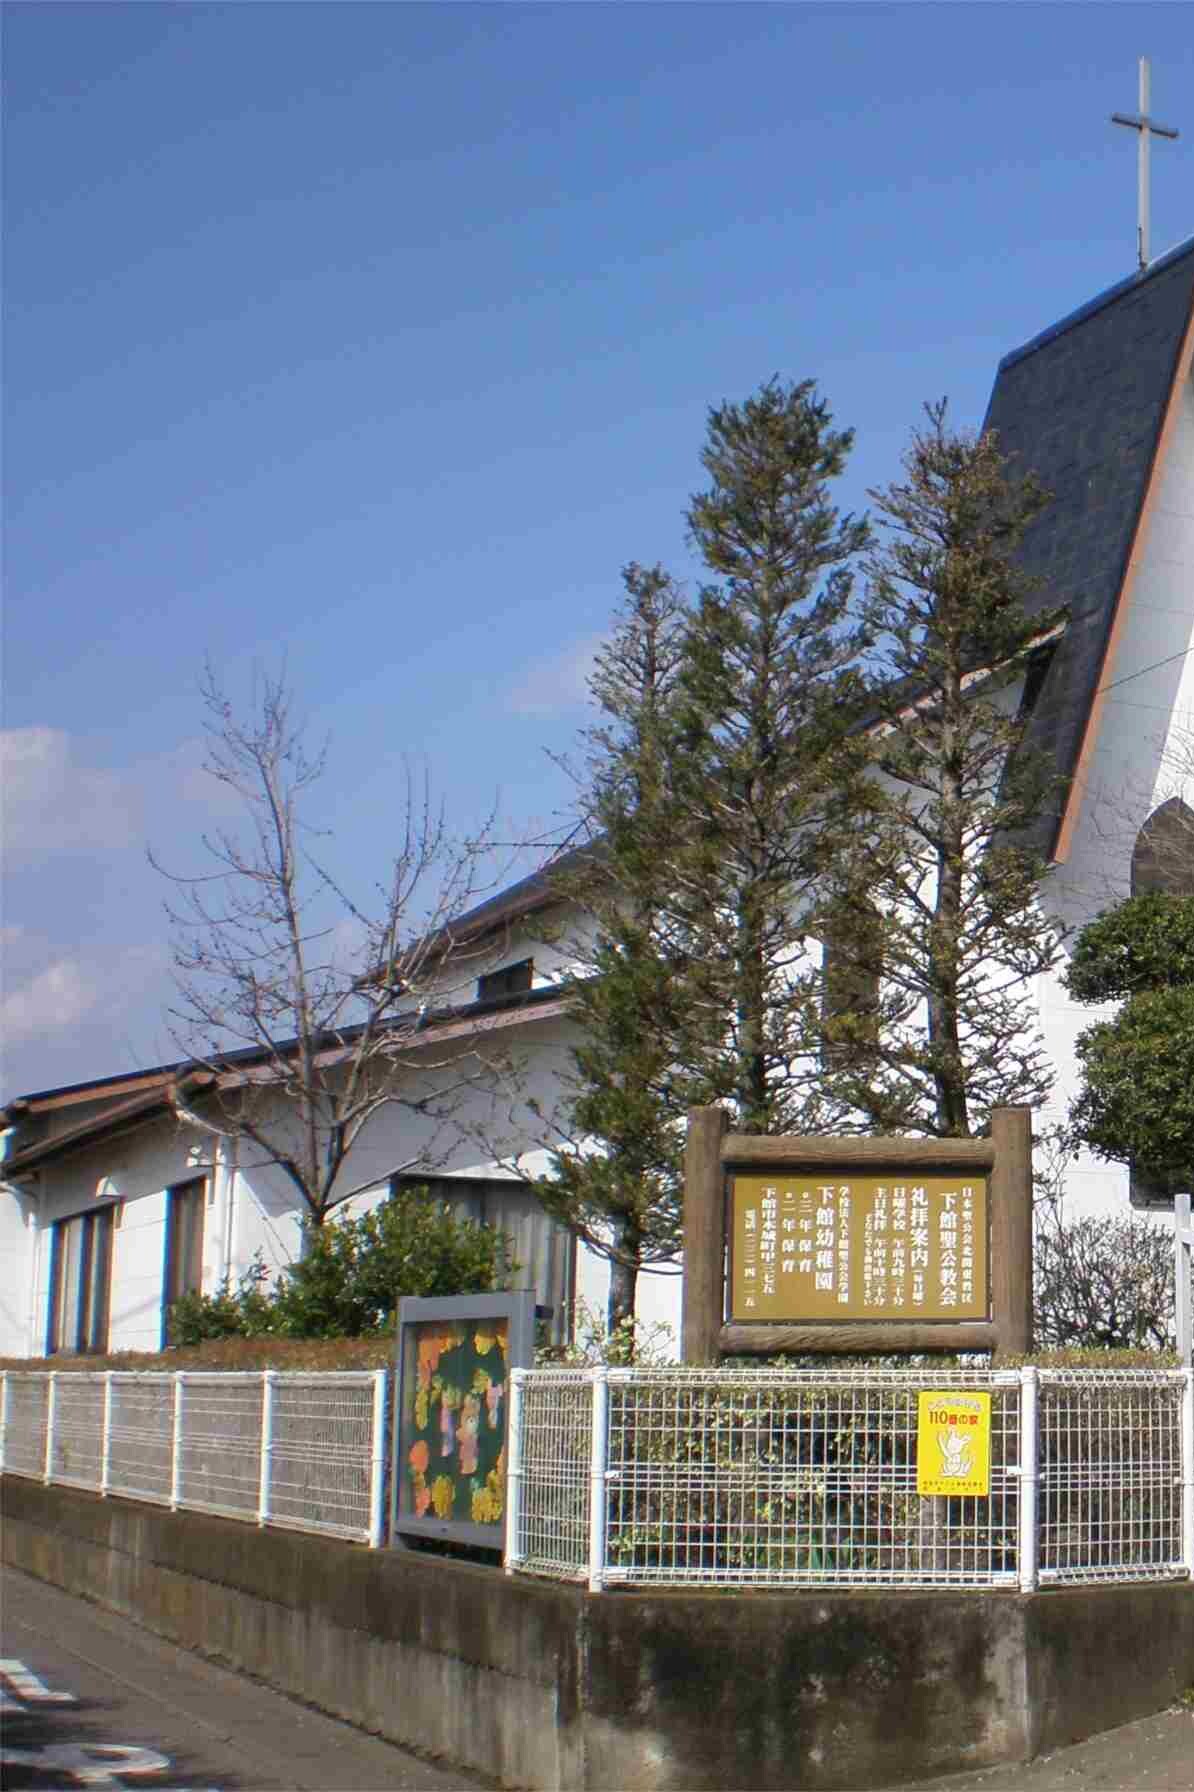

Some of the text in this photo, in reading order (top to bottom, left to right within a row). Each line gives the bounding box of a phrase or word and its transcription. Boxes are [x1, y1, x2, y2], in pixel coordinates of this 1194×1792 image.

[816, 1186, 835, 1290] 下館幼稚園
[939, 1192, 958, 1306] 下館聖公教会
